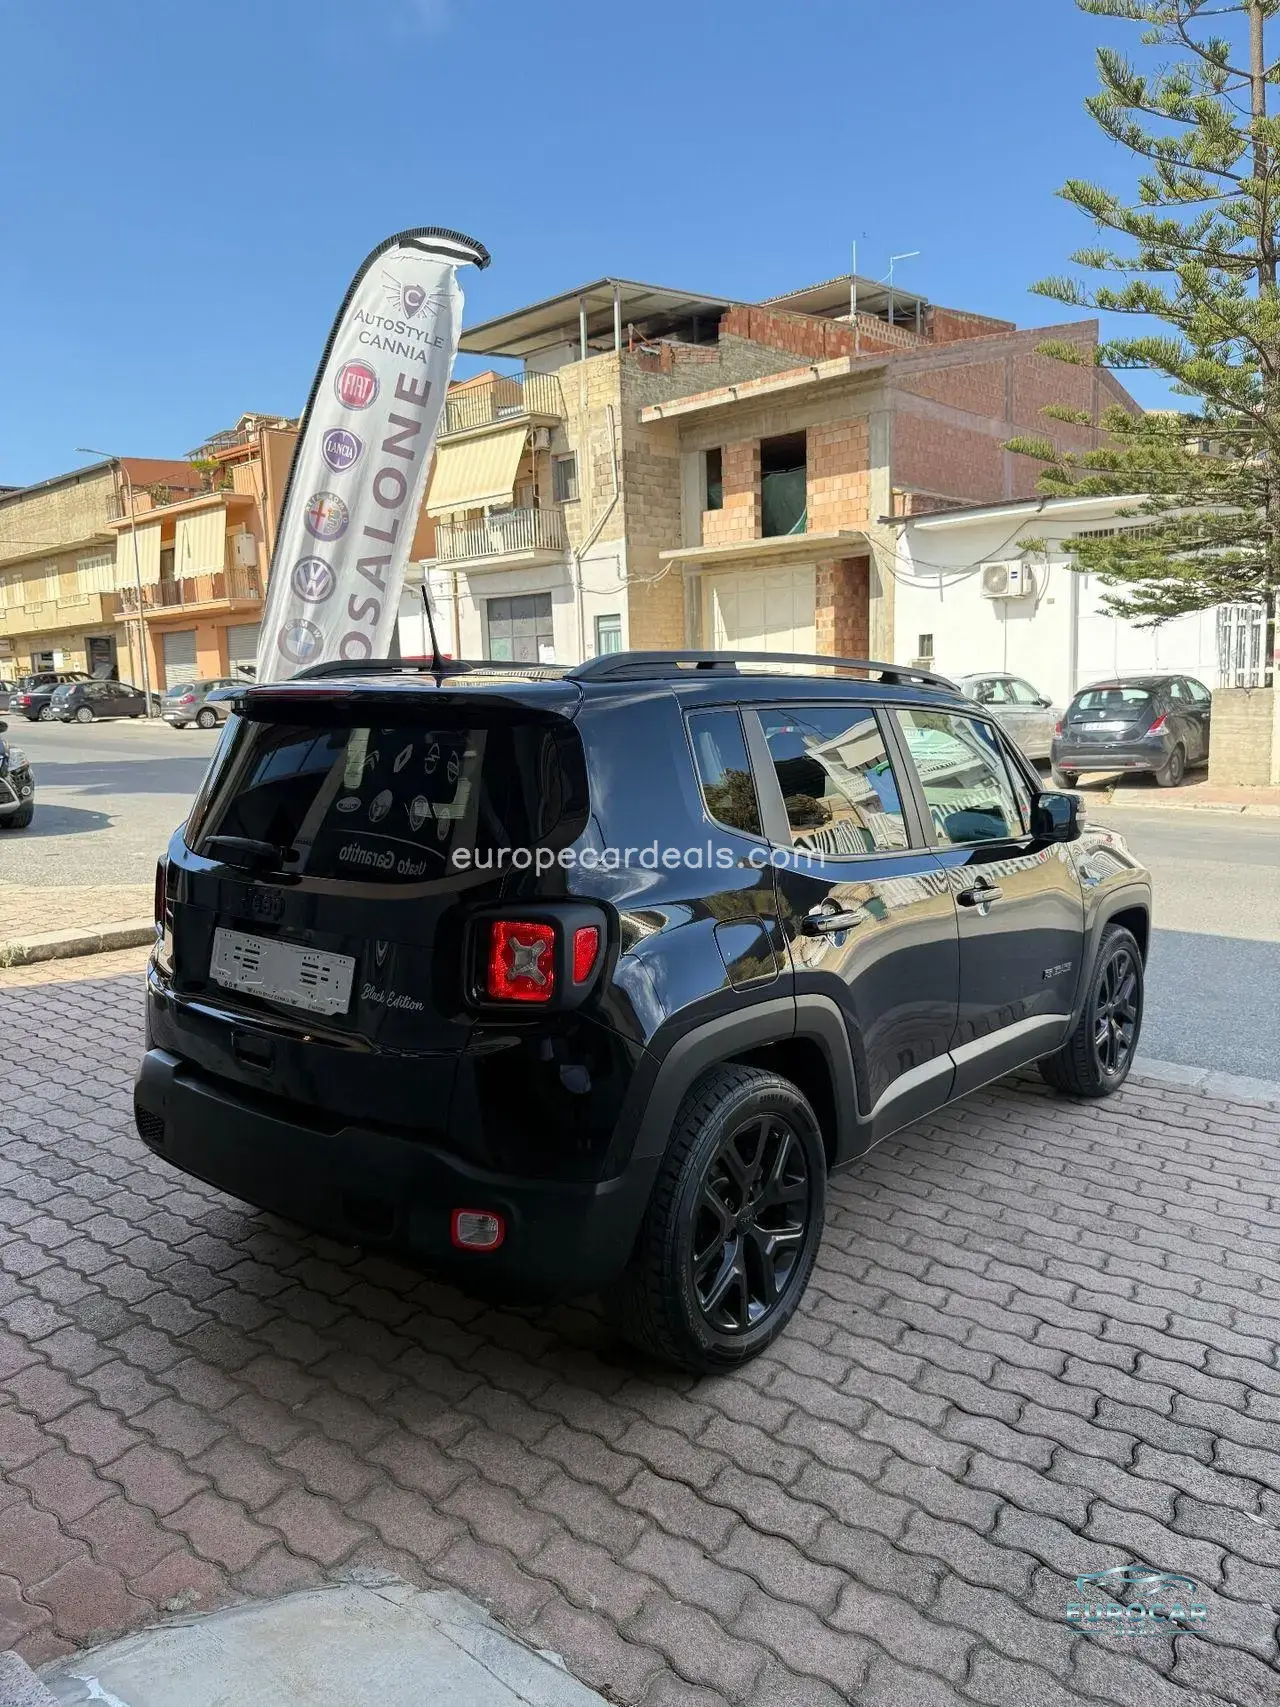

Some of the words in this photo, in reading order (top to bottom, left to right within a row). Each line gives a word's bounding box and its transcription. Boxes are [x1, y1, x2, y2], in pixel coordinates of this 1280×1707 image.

[405, 289, 422, 307] C
[354, 308, 444, 349] AUTOSTYLE
[359, 331, 427, 364] CANNIA
[343, 372, 371, 399] FIAT
[327, 440, 353, 460] LANCIA
[285, 620, 322, 639] BMW
[360, 982, 385, 1003] Black
[386, 992, 425, 1012] Edition
